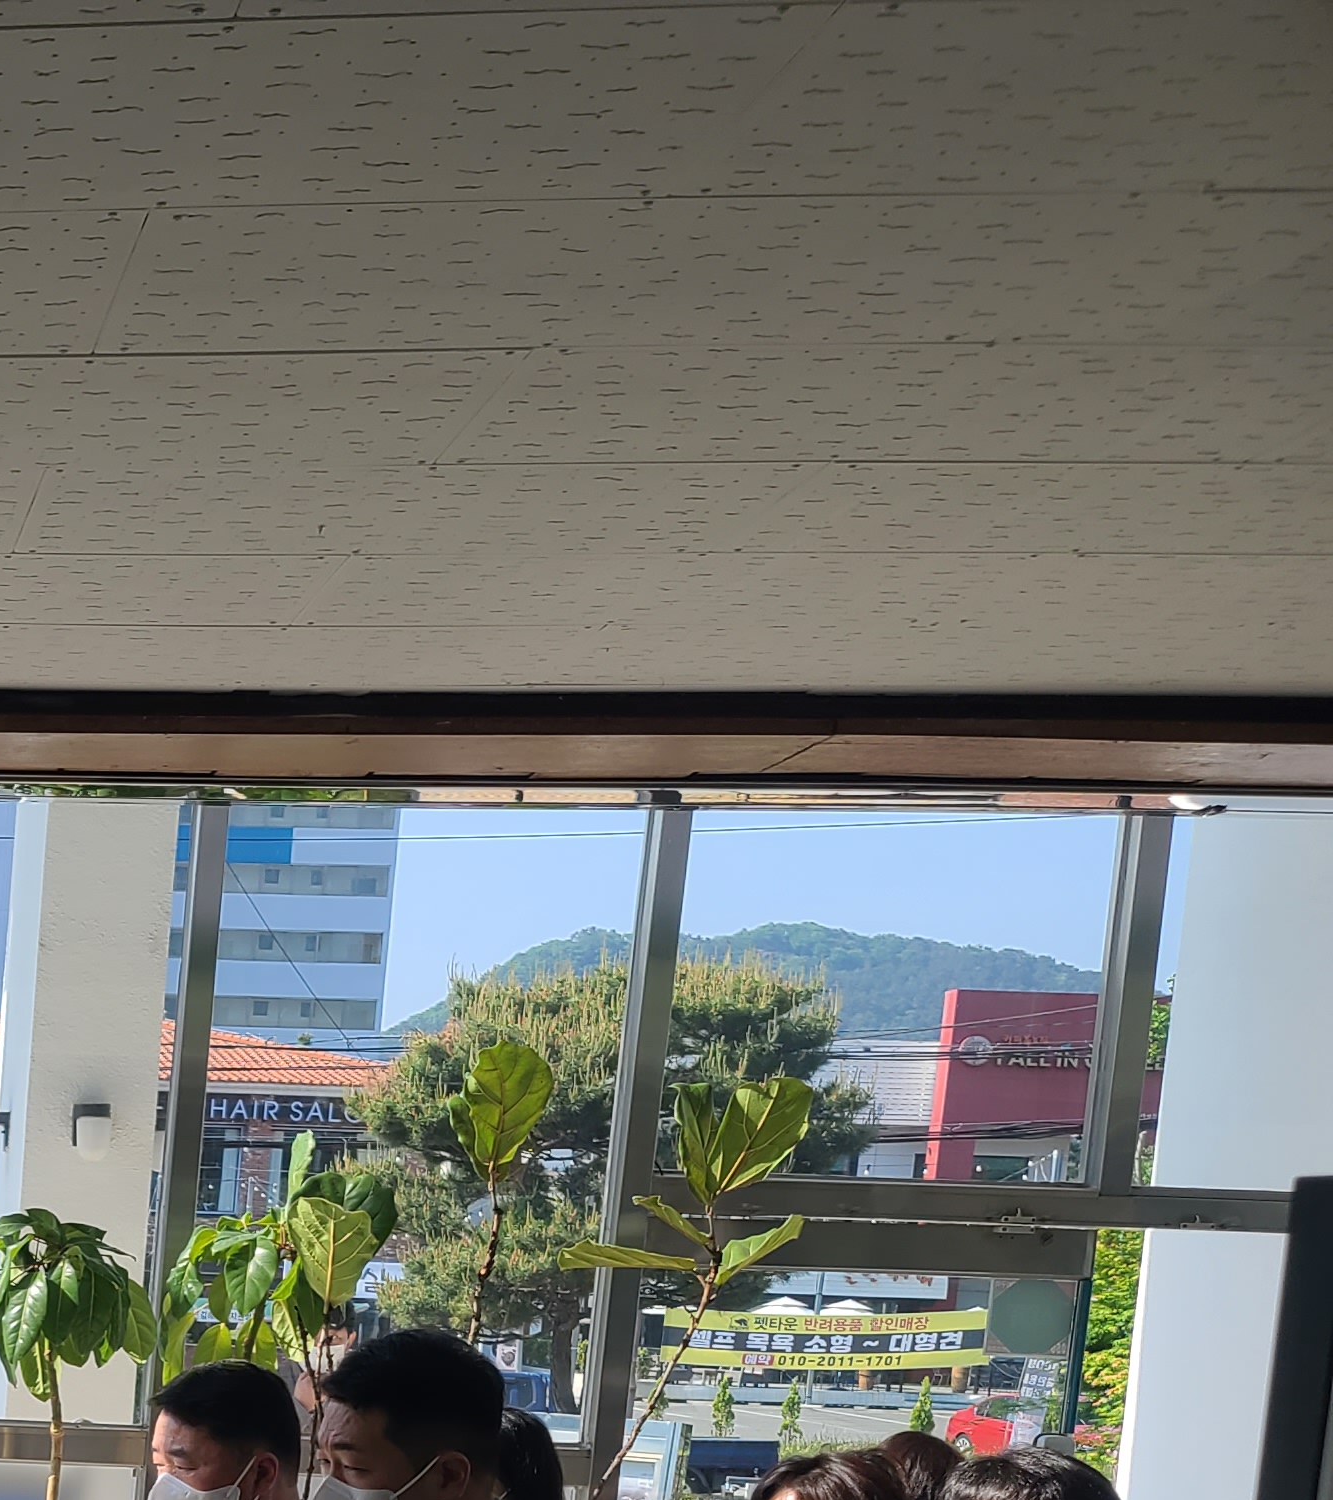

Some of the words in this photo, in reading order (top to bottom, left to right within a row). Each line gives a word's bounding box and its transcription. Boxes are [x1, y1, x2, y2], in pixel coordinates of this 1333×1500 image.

[210, 1098, 280, 1121] HAIR
[753, 1316, 799, 1331] 펫타운
[804, 1317, 863, 1332] 반려용품
[869, 1316, 930, 1331] 할인매장
[689, 1330, 736, 1348] 셀프
[745, 1333, 792, 1353] 목욕
[804, 1334, 854, 1353] 소형
[889, 1331, 963, 1352] 대형견
[743, 1354, 772, 1366] 예약
[778, 1354, 902, 1367] 010-2011-1701
